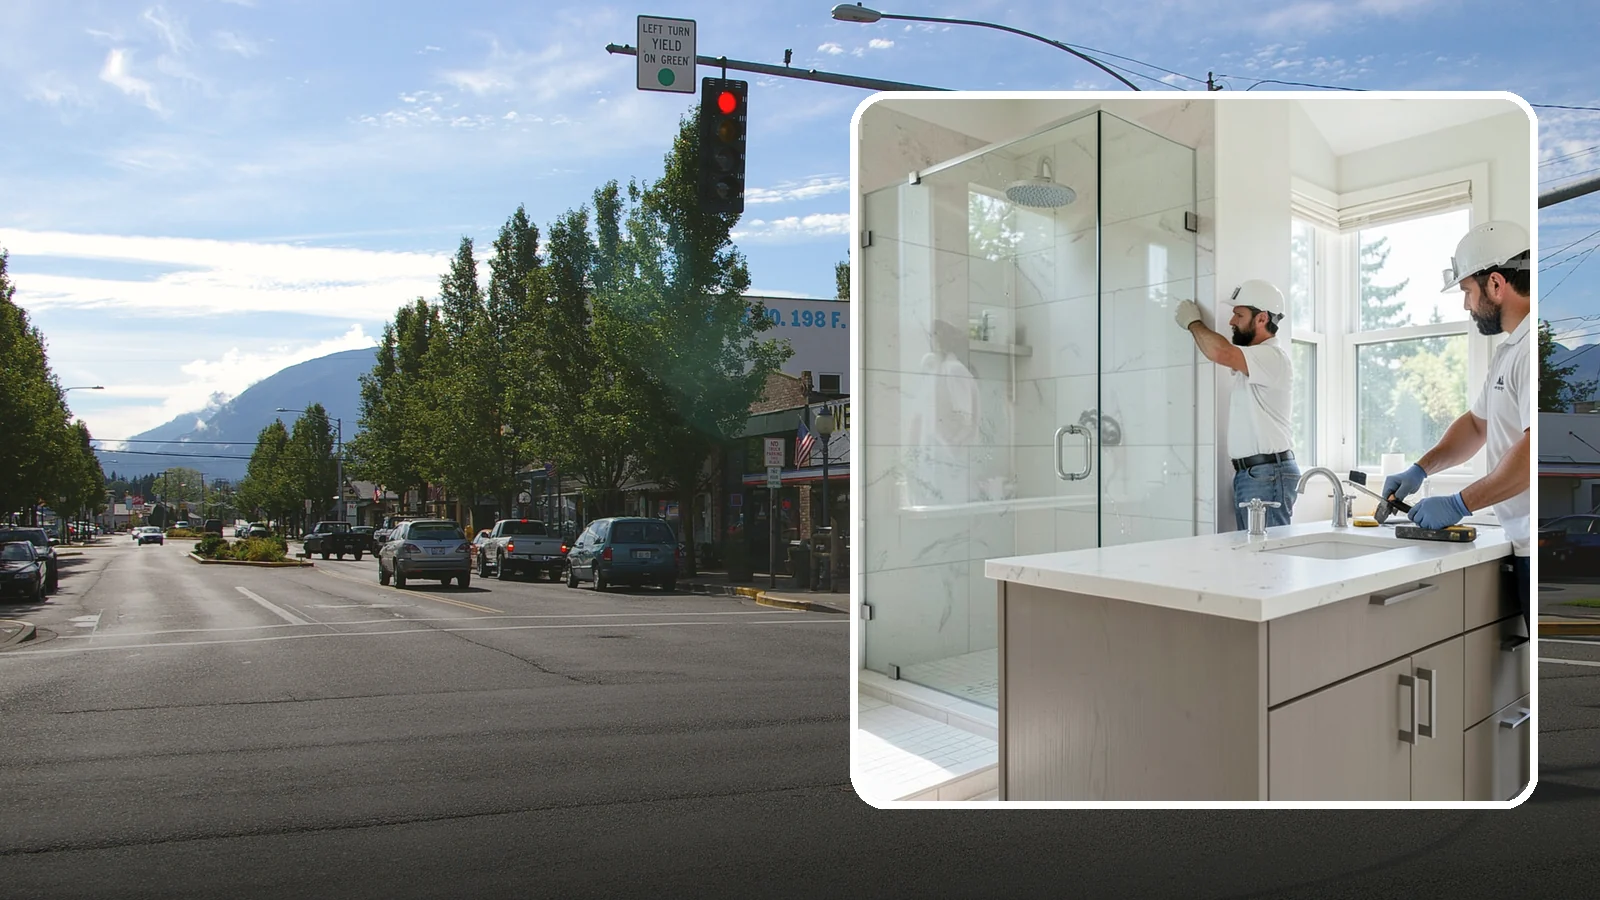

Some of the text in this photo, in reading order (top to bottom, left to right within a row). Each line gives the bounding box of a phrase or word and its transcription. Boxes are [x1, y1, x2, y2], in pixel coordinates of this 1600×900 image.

[643, 24, 690, 36] LEFT TURN
[652, 38, 682, 51] YIELD
[644, 53, 688, 66] ON GREEN
[791, 310, 826, 327] 198
[831, 311, 846, 328] F.
